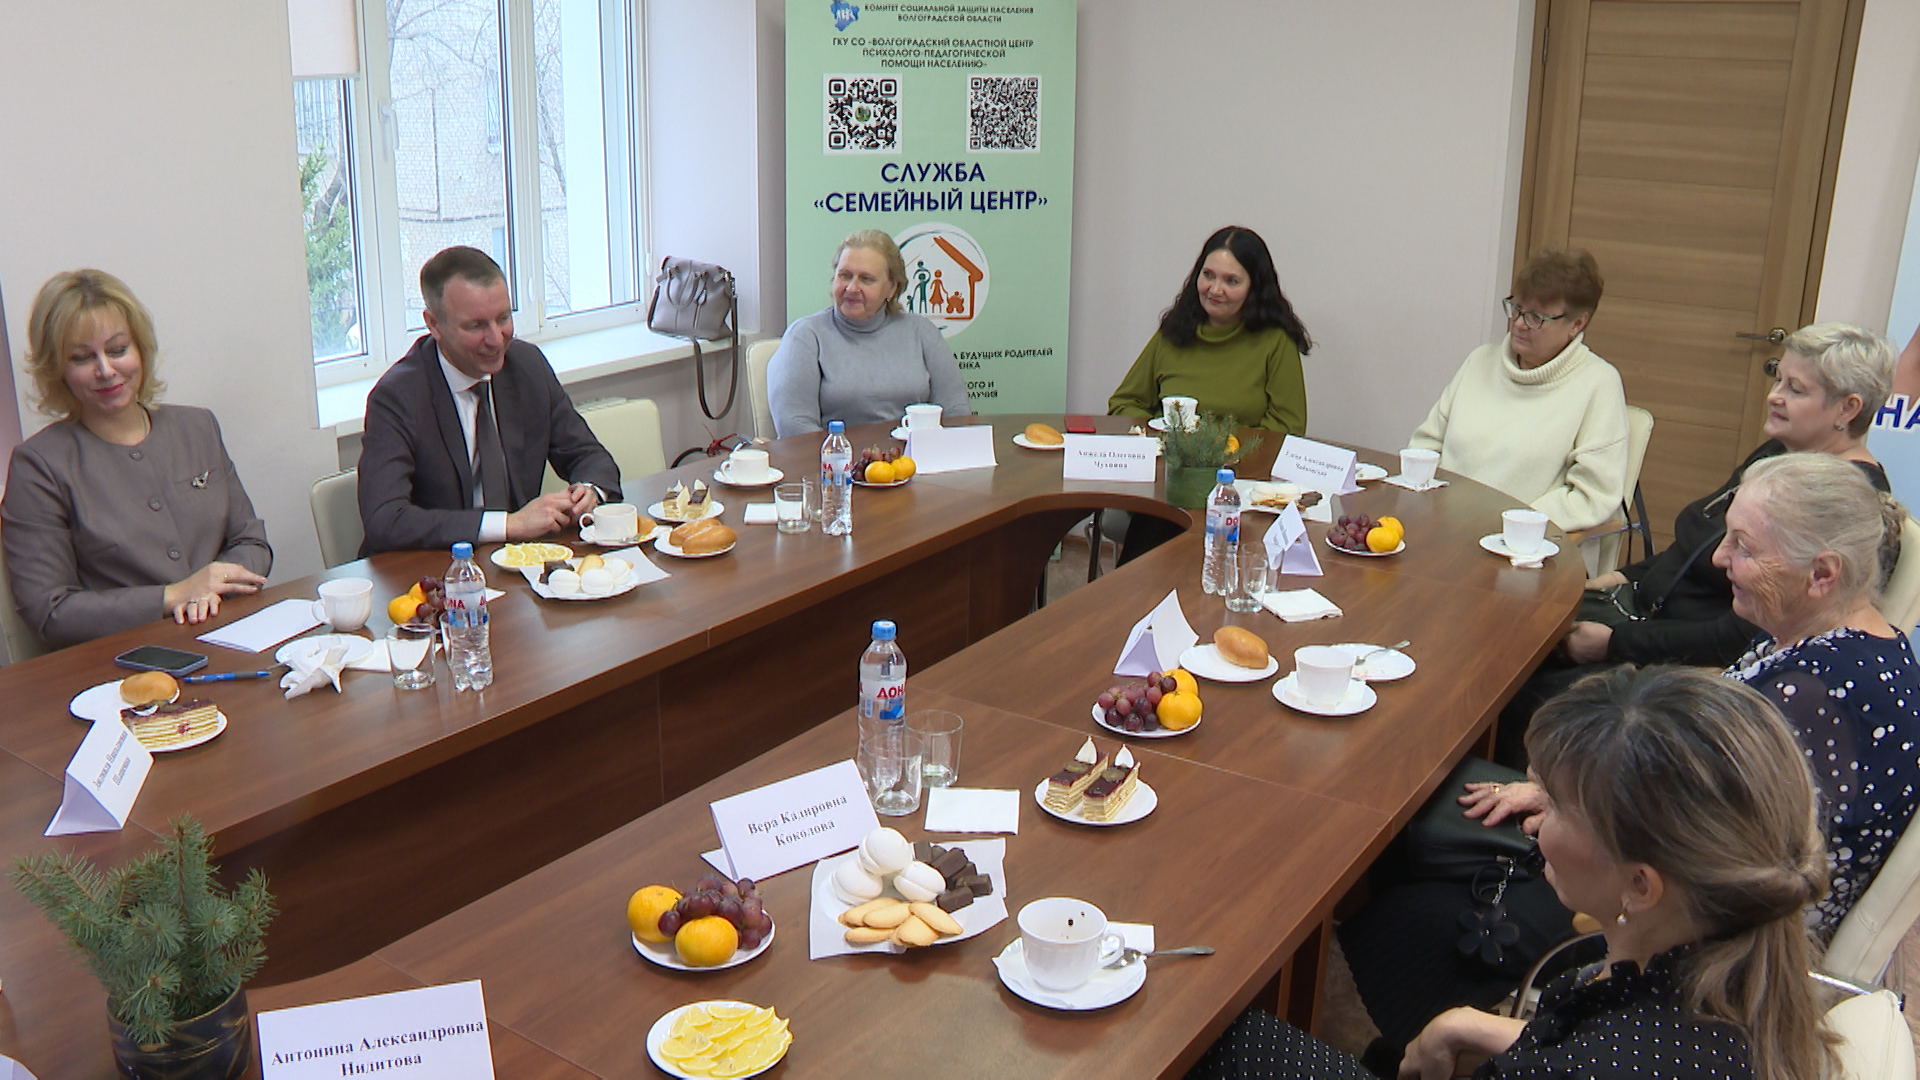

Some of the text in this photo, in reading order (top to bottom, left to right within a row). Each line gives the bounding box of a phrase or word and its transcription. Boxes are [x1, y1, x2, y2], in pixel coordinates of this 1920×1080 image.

[864, 4, 898, 12] КОМИТЕТ
[900, 4, 955, 13] СОЦИАЛЬНОЙ
[957, 5, 989, 14] ЗАЩИТЫ
[897, 13, 1002, 23] ВОЛГОГРАДСКОЙ ОБЛАСТИ
[832, 37, 849, 46] ГКУ
[850, 37, 866, 46] СО
[951, 38, 1007, 48] ОБЛАСТНОЙ
[1008, 39, 1034, 49] ЦЕНТР
[881, 59, 926, 69] ПОМОЩИ
[881, 162, 986, 183] СЛУЖБА
[813, 188, 1048, 214] «СЕМЕЙНЫЙ ЦЕНТР»
[960, 349, 1002, 360] БУДУЩИХ
[1004, 347, 1053, 358] РОДИТЕЛЕЙ
[958, 361, 981, 370] ЕНКА
[876, 683, 905, 699] ДОН
[747, 817, 779, 837] Вера
[271, 1020, 484, 1066] Антонина Александровна
